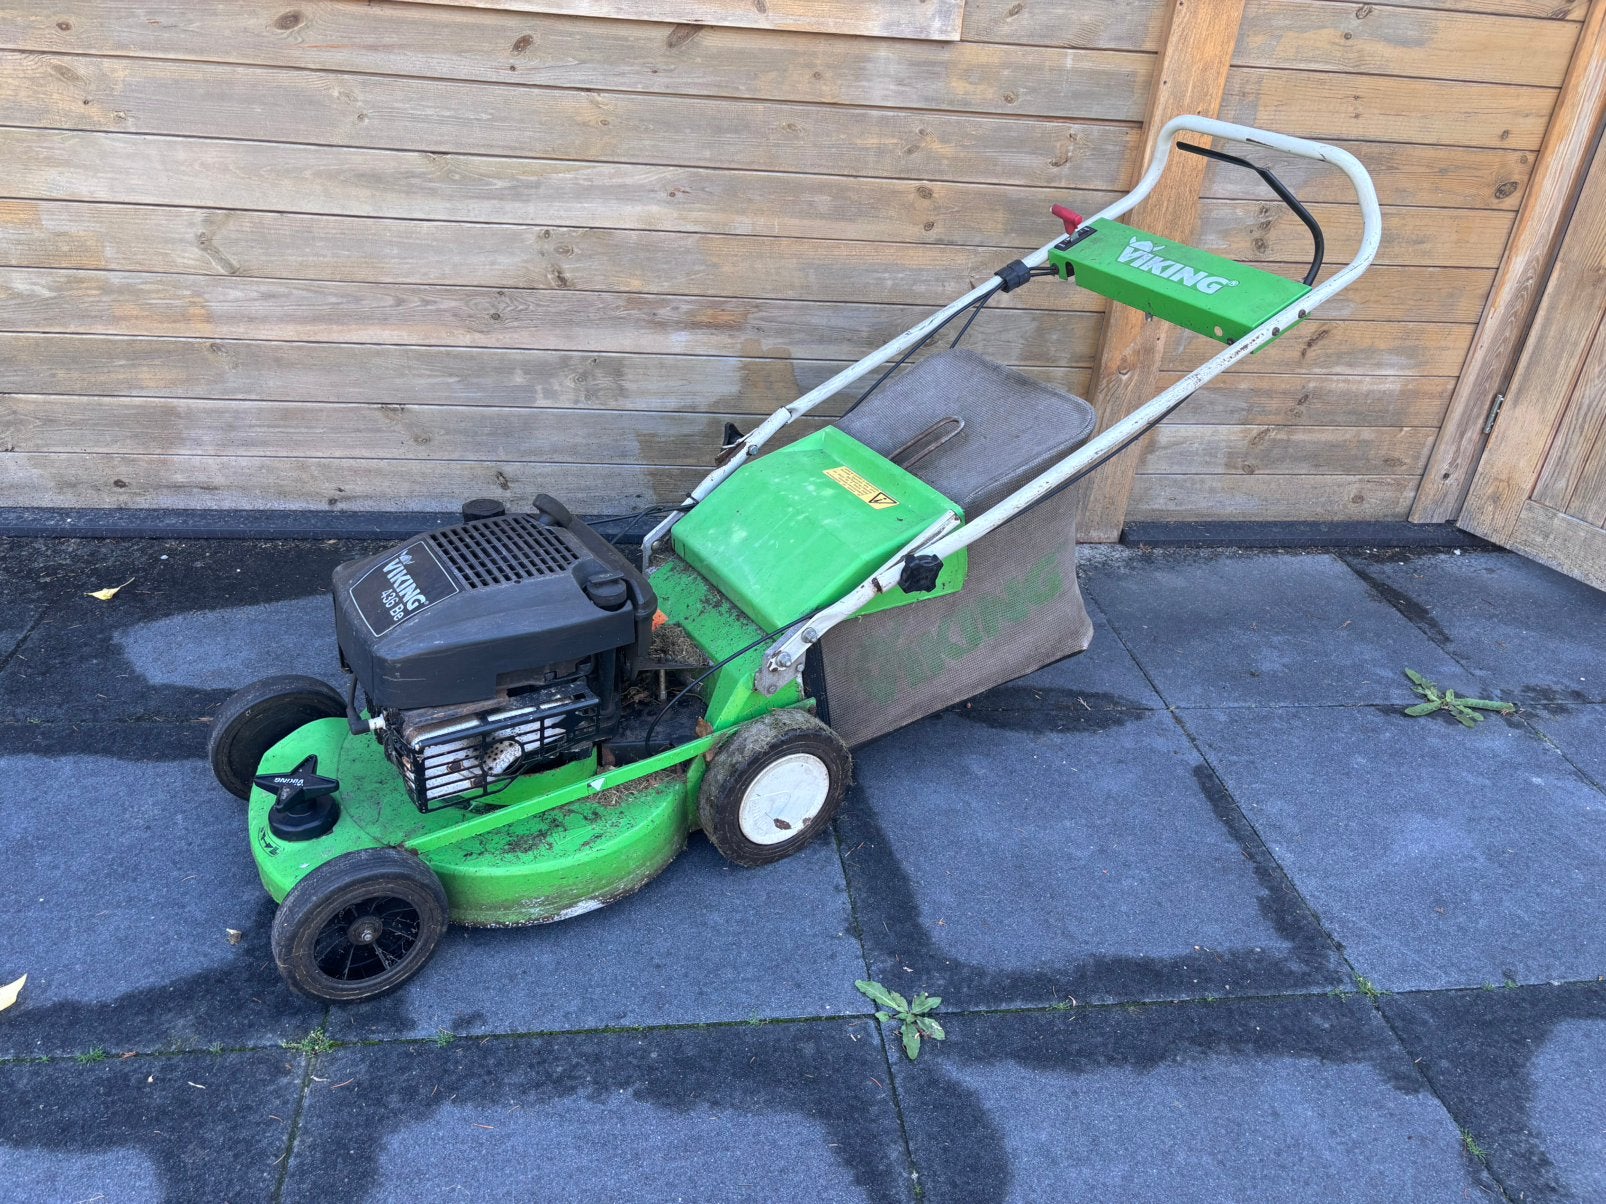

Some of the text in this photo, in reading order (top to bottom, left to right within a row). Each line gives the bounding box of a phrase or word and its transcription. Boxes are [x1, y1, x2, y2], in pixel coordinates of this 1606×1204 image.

[1117, 246, 1229, 295] VIKING
[381, 588, 405, 621] 436 Be
[382, 558, 427, 611] VIKING
[858, 552, 1064, 704] VIKING
